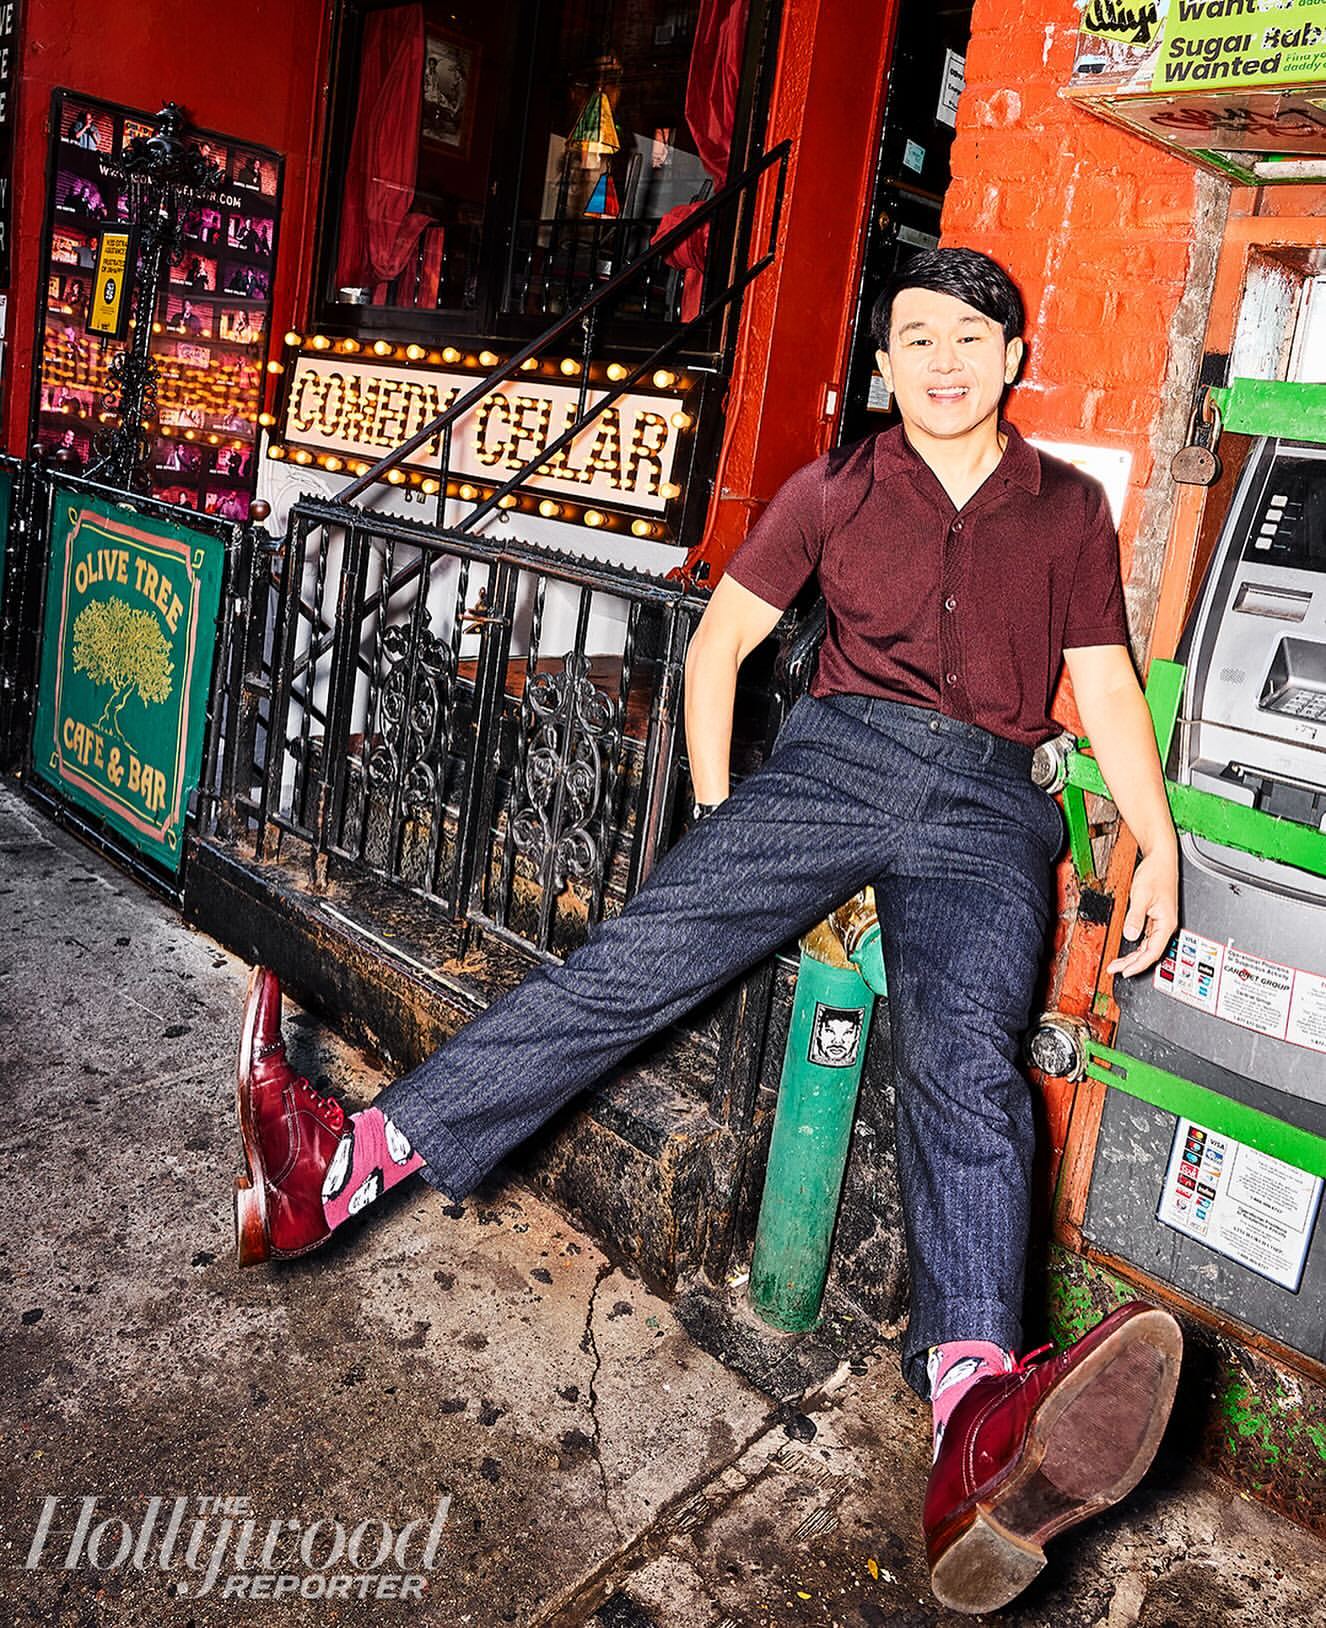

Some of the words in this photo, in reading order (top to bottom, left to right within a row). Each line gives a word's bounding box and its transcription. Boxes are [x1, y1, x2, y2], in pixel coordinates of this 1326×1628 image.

[1169, 34, 1252, 62] Sugar
[1165, 52, 1281, 82] Wanted
[1283, 62, 1321, 72] daddy
[290, 369, 460, 459] COMEDY
[475, 392, 670, 497] CELLAR
[75, 549, 130, 595] OLIVE
[134, 555, 185, 635] TREE
[63, 716, 105, 769] CAFE
[106, 746, 124, 788] &
[127, 755, 167, 811] BAR
[1209, 1138, 1225, 1150] VISA
